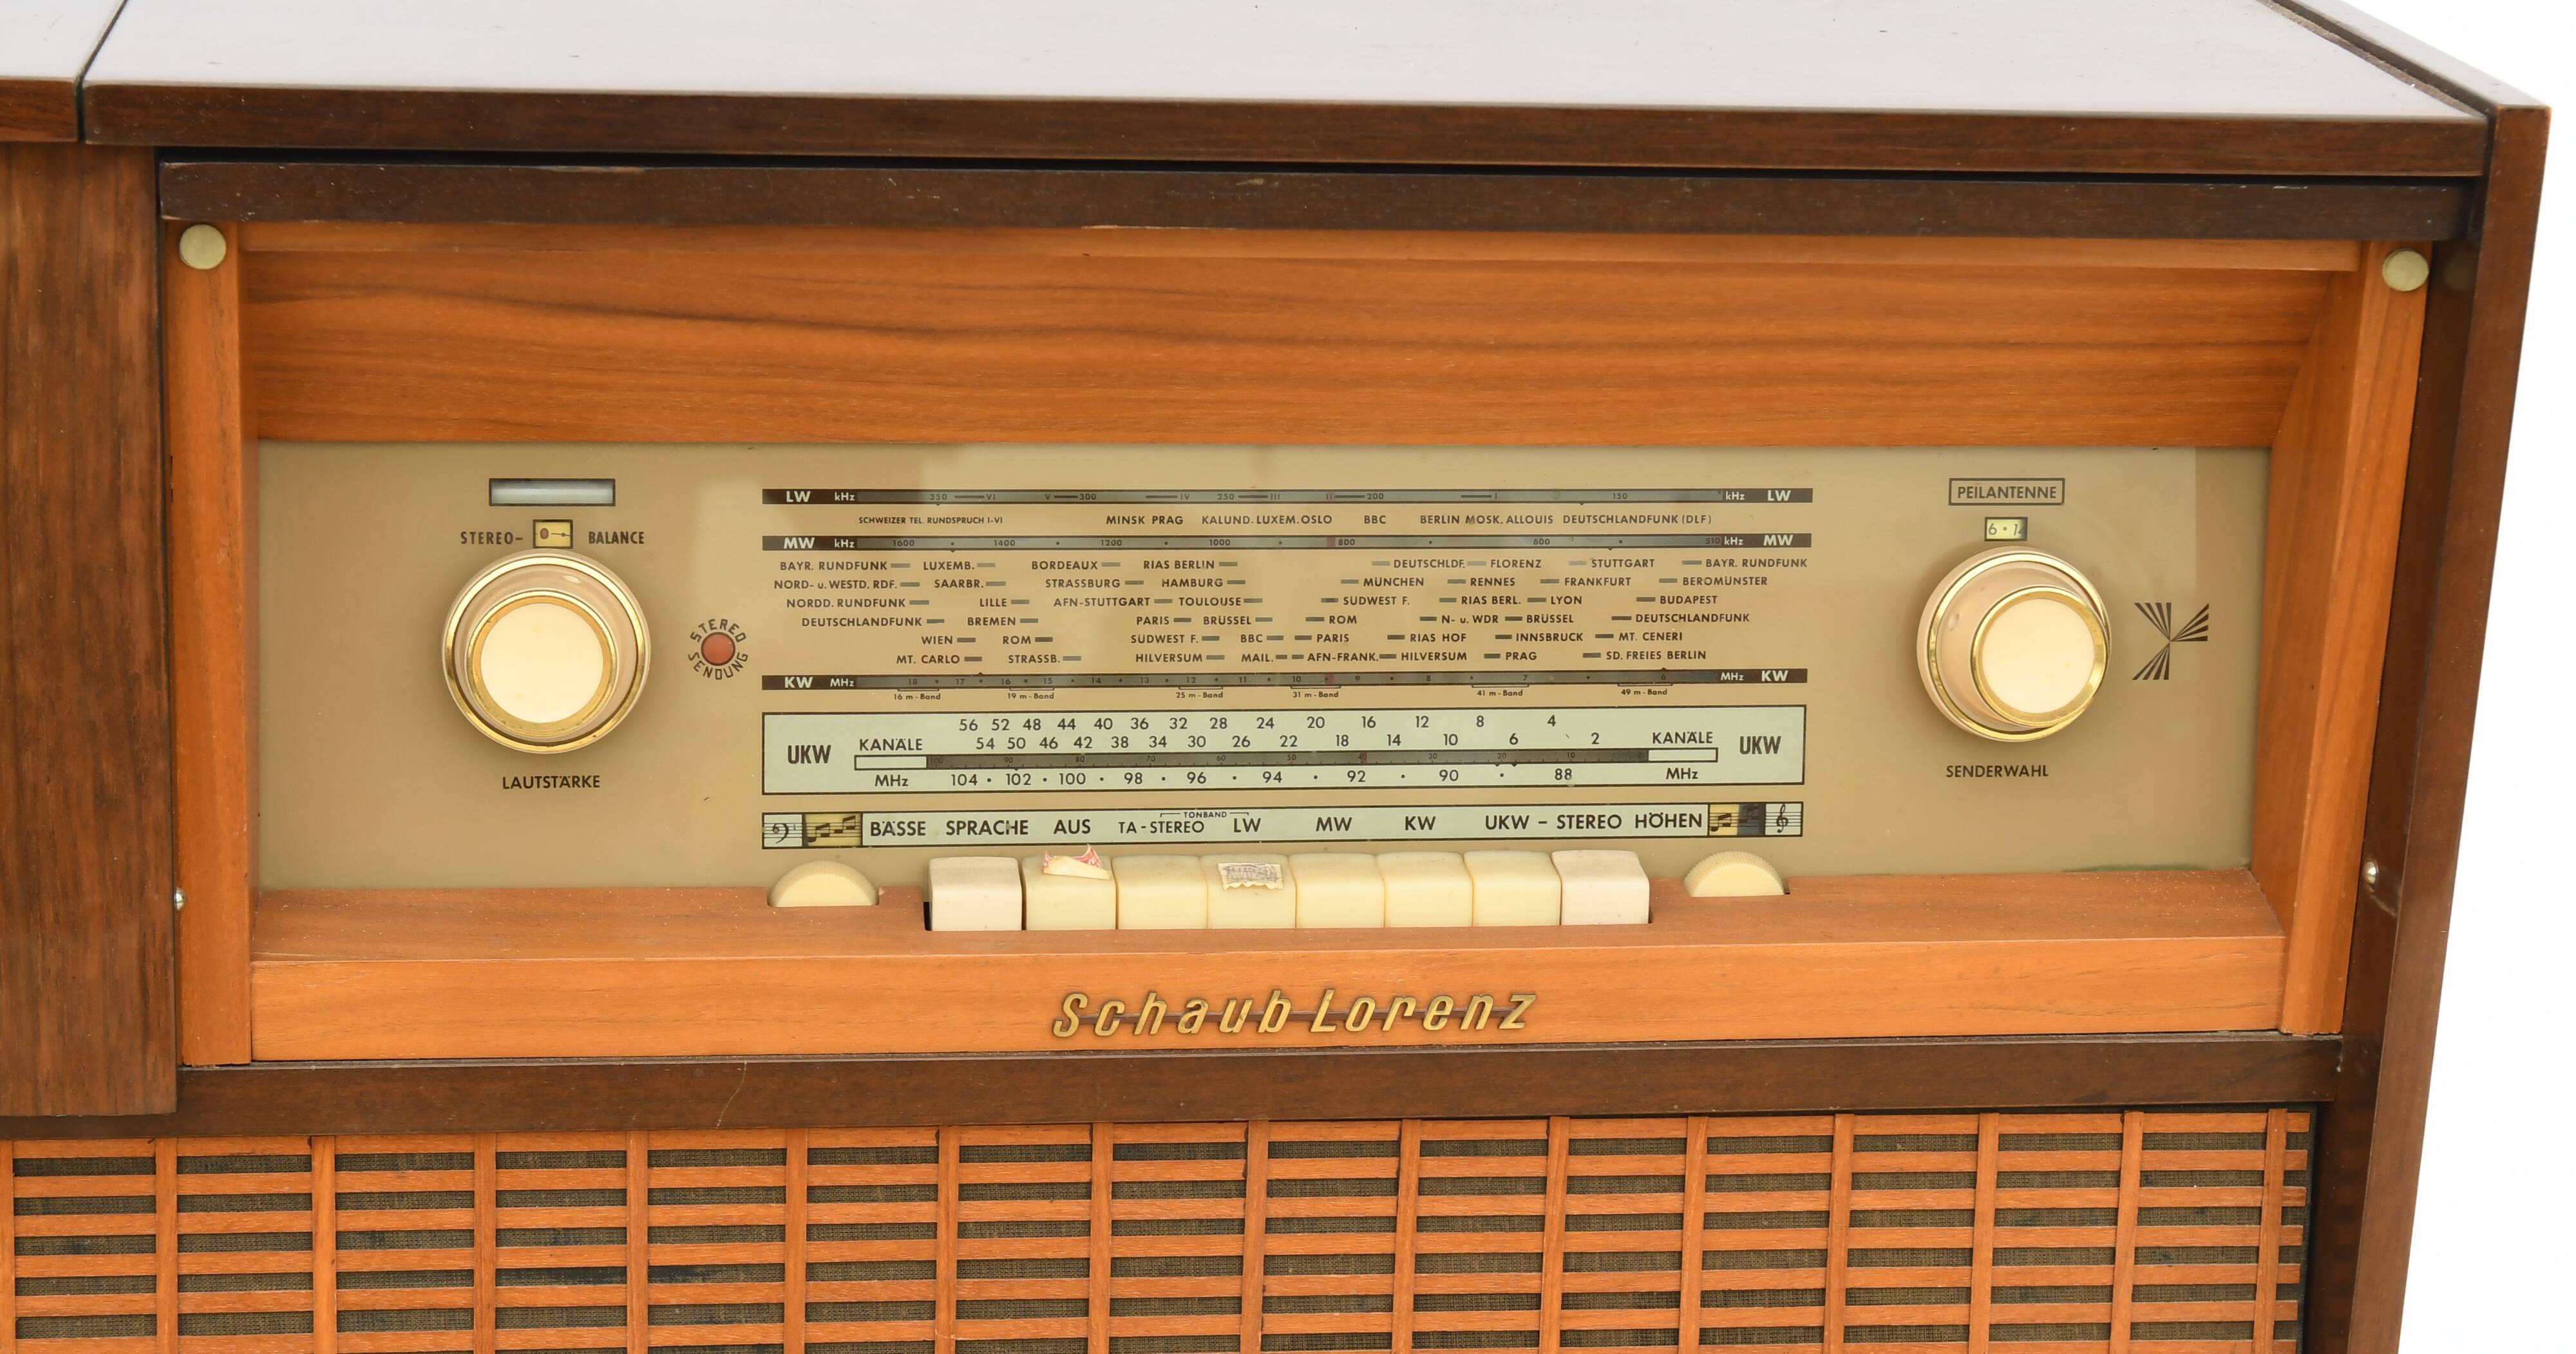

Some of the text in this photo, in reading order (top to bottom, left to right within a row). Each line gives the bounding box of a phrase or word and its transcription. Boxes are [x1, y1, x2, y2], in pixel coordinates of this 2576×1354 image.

[786, 490, 811, 502] LW
[834, 491, 855, 501] kHz
[1725, 491, 1745, 501] kHz
[1767, 490, 1792, 502] LW
[1957, 486, 2057, 499] PEILANTENNE
[1106, 515, 1145, 525] MINSK
[1151, 515, 1184, 525] PRAG
[1202, 515, 1254, 525] KALUND.
[1256, 515, 1300, 524] LUXEM.
[1301, 515, 1332, 524] OSLO
[1364, 515, 1387, 524] BBC
[1420, 515, 1460, 524] BERLIN
[1464, 515, 1503, 524] MOSK.
[1506, 515, 1553, 524] ALLOUIS
[1563, 514, 1712, 525] DEUTSCHLANDFUNK (DLF)
[588, 531, 645, 544] BALANCE
[1724, 536, 1743, 546] kHz
[1763, 534, 1794, 546] MW
[783, 537, 815, 549] MW
[834, 538, 855, 548] kHz
[780, 561, 887, 571] BAYR. RUNDFUNK
[923, 561, 975, 571] LUXEMB.
[1032, 560, 1098, 570] BORDEAUX
[1143, 560, 1215, 569] RIAS BERLIN
[1394, 558, 1466, 569] DEUTSCHLDF.
[1490, 559, 1542, 568] FLORENZ
[1591, 558, 1655, 568] STUTTGART
[1705, 558, 1808, 567] BAYR. RUNDFUNK
[829, 580, 870, 589] WESTD.
[873, 580, 897, 589] RDF.
[934, 579, 984, 588] SAARBR.
[1045, 578, 1121, 588] STRASSBURG
[1162, 578, 1224, 587] HAMBURG
[1363, 577, 1424, 587] MÜNCHEN
[1470, 577, 1515, 587] RENNES
[1564, 577, 1631, 586] FRANKFURT
[1682, 576, 1768, 586] BEROMÜNSTER
[786, 598, 905, 608] NORDD. RUNDFUNK
[980, 598, 1007, 607] LILLE
[1179, 596, 1241, 607] TOULOUSE
[1343, 595, 1410, 605] SÜDWEST F.
[1461, 595, 1521, 605] RIAS BERL.
[1551, 595, 1582, 605] LYON
[1660, 595, 1718, 605] BUDAPEST
[802, 617, 922, 627] DEUTSCHLANDFUNK
[967, 616, 1016, 626] BREMEN
[1136, 616, 1170, 625] PARIS
[1203, 615, 1252, 625] BRÜSSEL
[1329, 615, 1357, 624] ROM
[1472, 615, 1499, 624] WDR
[1526, 613, 1574, 624] BRÜSSEL
[1636, 613, 1750, 623] DEUTSCHLANDFUNK
[690, 618, 746, 643] STEREO
[921, 635, 953, 645] WIEN
[1003, 635, 1032, 645] ROM
[1131, 634, 1198, 644] SÜDWEST F.
[1240, 634, 1263, 643] BBC
[1316, 633, 1349, 643] PARIS
[1410, 633, 1466, 642] RIAS HOF
[1516, 633, 1584, 642] INNSBRUCK
[1618, 631, 1683, 642] MT. CENERI
[896, 654, 960, 664] MT. CARLO
[1008, 654, 1060, 664] STRASSB.
[1135, 653, 1203, 663] HILVERSUM
[1241, 653, 1274, 662] MAIL.
[1401, 651, 1467, 661] HILVERSUM
[1506, 651, 1537, 661] PRAG
[1606, 650, 1706, 660] SD. FREIES BERLIN
[688, 651, 748, 680] SENDUNG
[1720, 672, 1744, 681] MHz
[1761, 670, 1788, 682] KW
[784, 676, 813, 689] KW
[829, 678, 855, 687] MHz
[959, 718, 978, 732] 56
[991, 718, 1010, 731] 52
[1022, 718, 1041, 731] 48
[1094, 718, 1113, 730] 40
[1130, 717, 1149, 730] 36
[1169, 717, 1188, 730] 32
[1256, 716, 1275, 729] 24
[1653, 731, 1713, 745] KANÄLE
[859, 738, 923, 751] KANÄLE
[1740, 736, 1781, 754] UKW
[788, 745, 831, 764] UKW
[1262, 770, 1283, 783] 94
[1347, 770, 1366, 783] 92
[1439, 769, 1459, 782] 90
[1555, 768, 1572, 781] 88
[1665, 767, 1698, 780] MHz
[1946, 765, 2049, 778] SENDERWAHL
[502, 775, 600, 790] LAUTSTÄRKE
[875, 774, 909, 787] MHz
[951, 774, 978, 787] 104
[1005, 773, 1031, 786] 102
[1059, 772, 1086, 785] 100
[1124, 772, 1143, 785] 98
[1186, 771, 1207, 785] 96
[1233, 817, 1262, 833] LW
[1316, 816, 1352, 832] MW
[1405, 815, 1436, 831] KW
[1485, 814, 1622, 830] UKW STEREO
[1636, 812, 1701, 828] HÖHEN
[871, 821, 925, 836] BÄSSE
[946, 820, 1028, 835] SPRACHE
[1054, 819, 1090, 834] AUS
[1118, 820, 1204, 834] TA STEREO
[1052, 988, 1537, 1038] Schaub Lorenz
